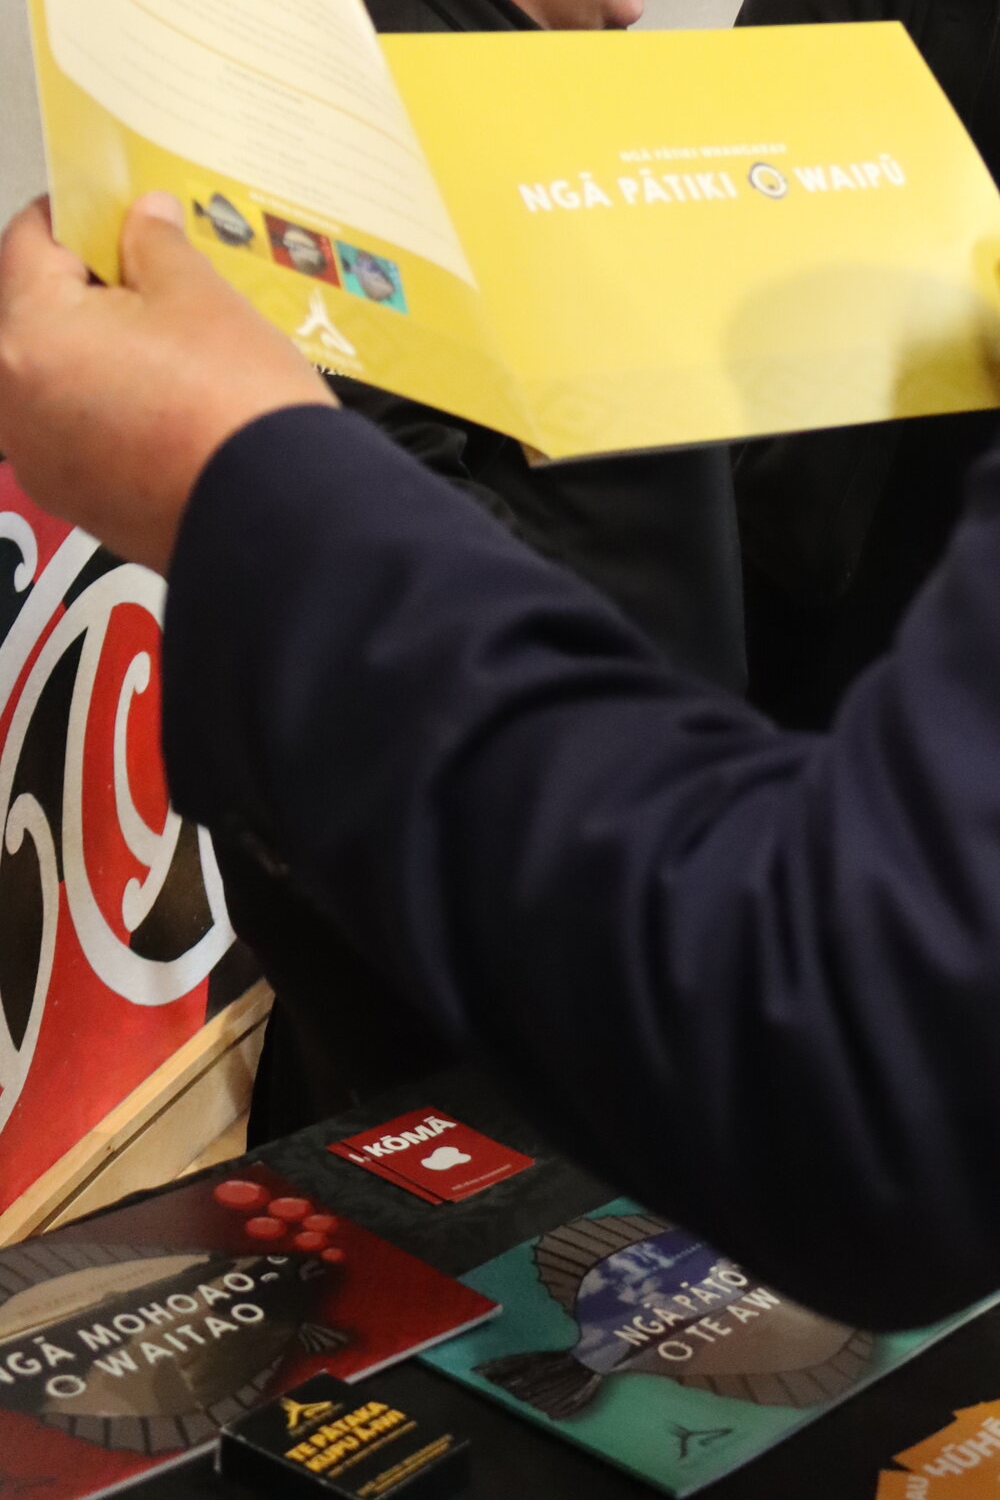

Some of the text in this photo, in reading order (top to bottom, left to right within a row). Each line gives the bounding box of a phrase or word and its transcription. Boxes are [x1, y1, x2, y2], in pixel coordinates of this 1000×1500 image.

[517, 171, 614, 214] NGĀ
[616, 167, 738, 205] PĀTIKI
[791, 152, 906, 193] WAIPŪ
[362, 1116, 457, 1158] KŌMĀ
[613, 1302, 685, 1346] NGĀ
[657, 1340, 694, 1362] O
[684, 1316, 733, 1343] TE
[45, 1303, 265, 1398] O WAITAO
[284, 1441, 319, 1463] TE
